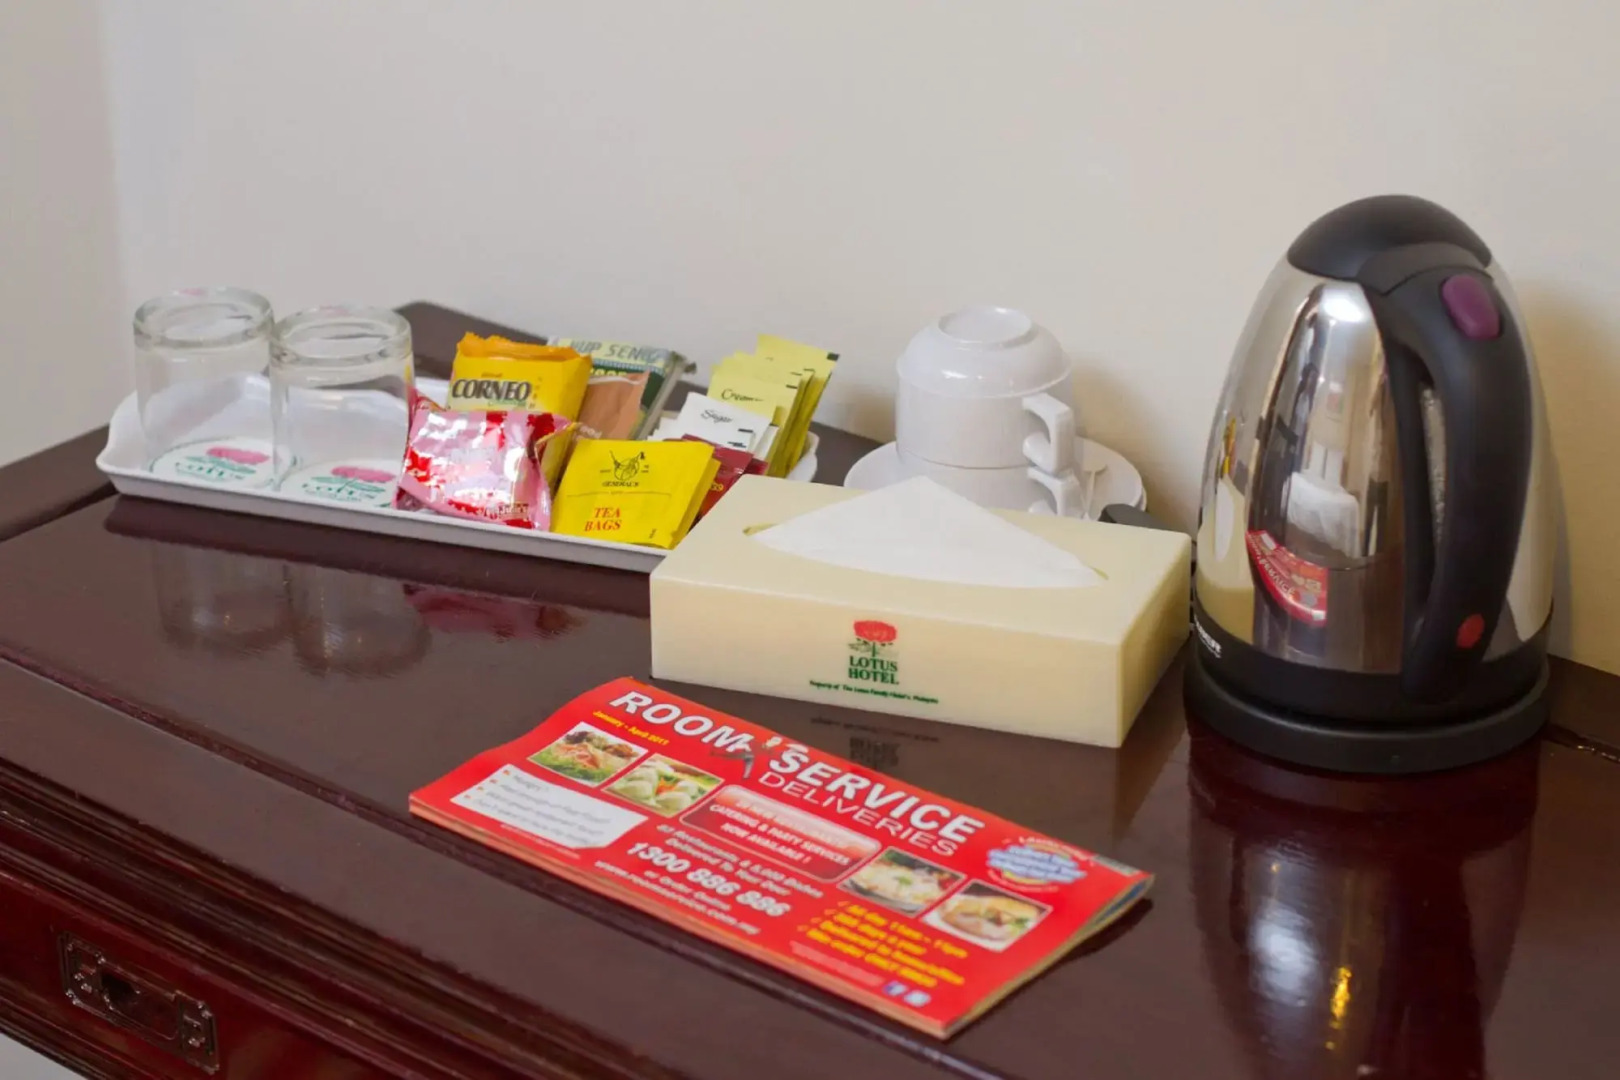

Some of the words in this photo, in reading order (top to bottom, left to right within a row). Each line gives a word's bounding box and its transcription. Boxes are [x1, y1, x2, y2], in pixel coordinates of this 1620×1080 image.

[452, 378, 532, 401] CORNEO
[701, 408, 734, 424] Sugar
[584, 518, 622, 532] BAGS
[594, 507, 621, 519] TEA
[848, 667, 899, 685] HOTEL
[849, 655, 898, 672] LOTUS
[592, 710, 623, 728] January
[628, 726, 650, 742] April
[608, 690, 755, 753] ROOM
[769, 743, 986, 844] SERVICE
[758, 771, 960, 857] DELIVERIES
[709, 804, 760, 828] CATERING
[758, 823, 768, 832] &
[769, 826, 801, 845] PARTY
[800, 841, 850, 866] SERVICES
[720, 822, 749, 838] NOW
[747, 833, 805, 862] AVAILABLE
[626, 842, 691, 873] 1300
[686, 868, 741, 896] 886
